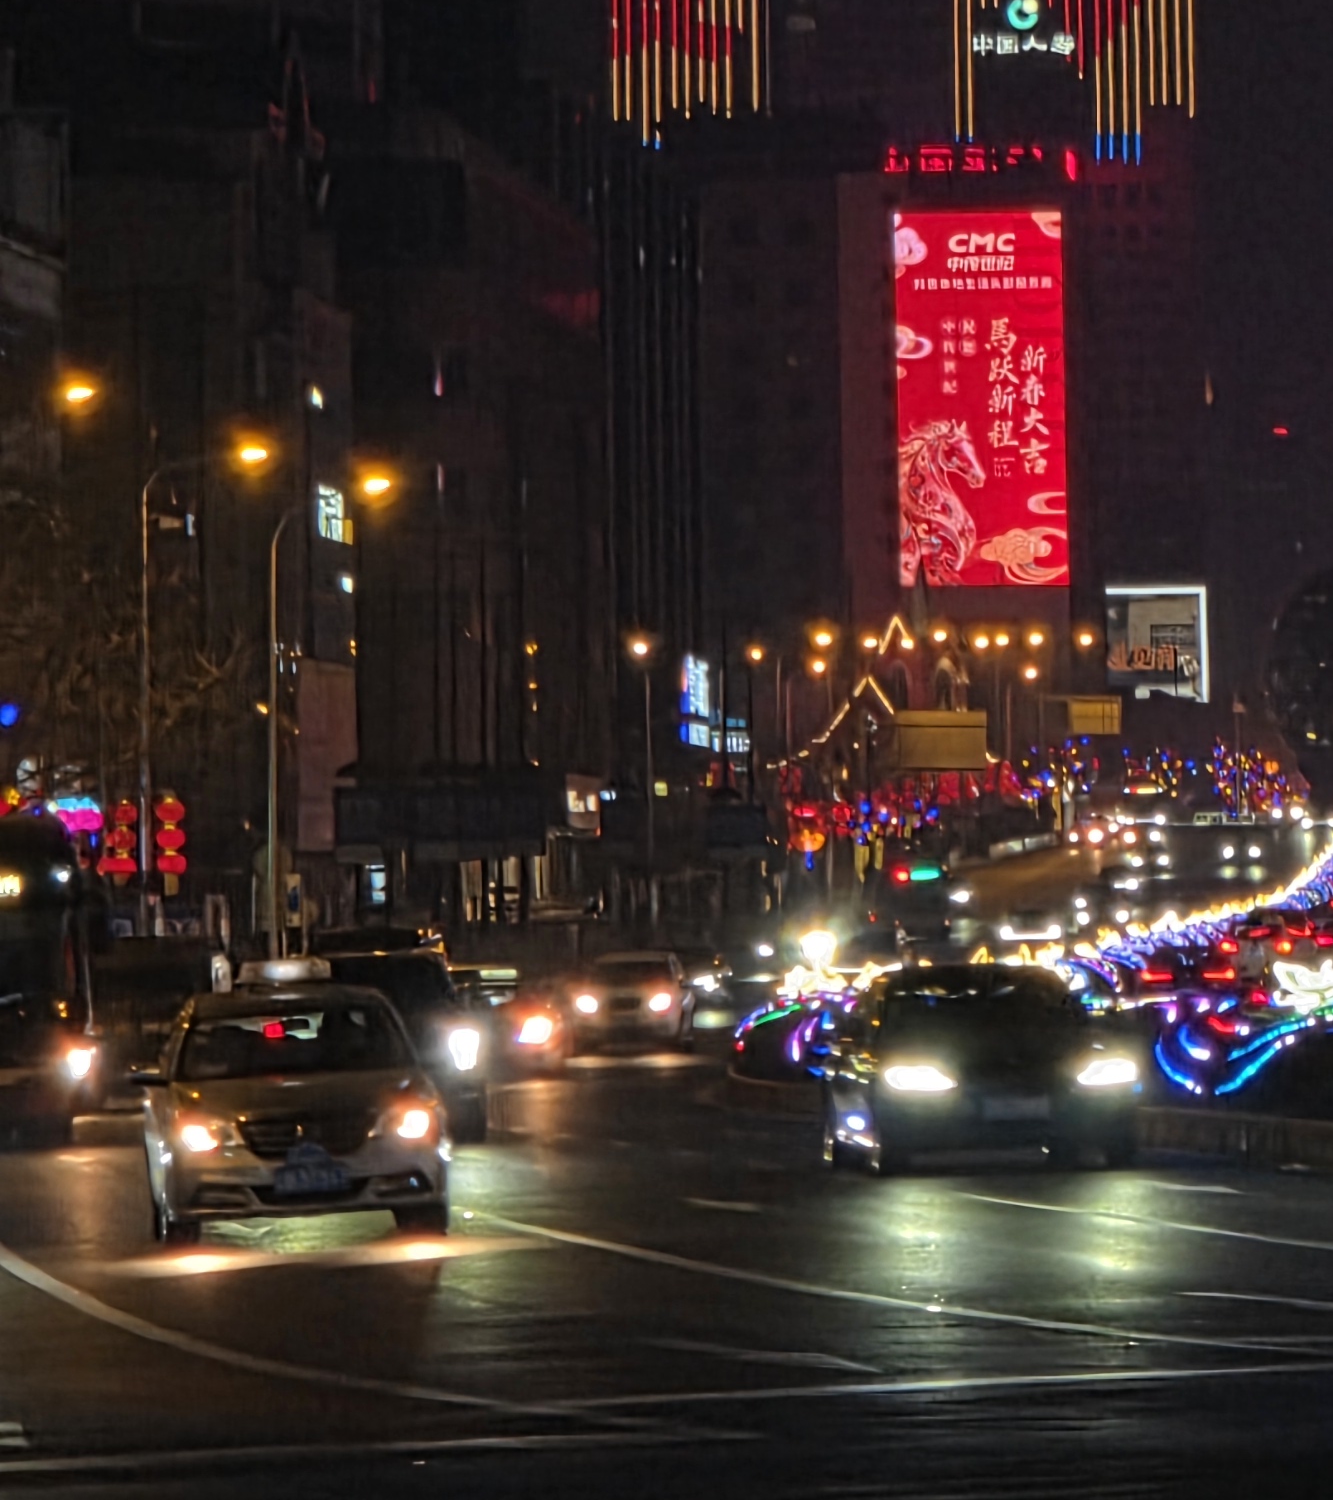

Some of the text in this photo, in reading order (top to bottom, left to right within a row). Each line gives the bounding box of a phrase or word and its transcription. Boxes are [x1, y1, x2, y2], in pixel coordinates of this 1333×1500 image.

[948, 233, 1016, 254] CMC
[1020, 344, 1051, 474] 新春大吉
